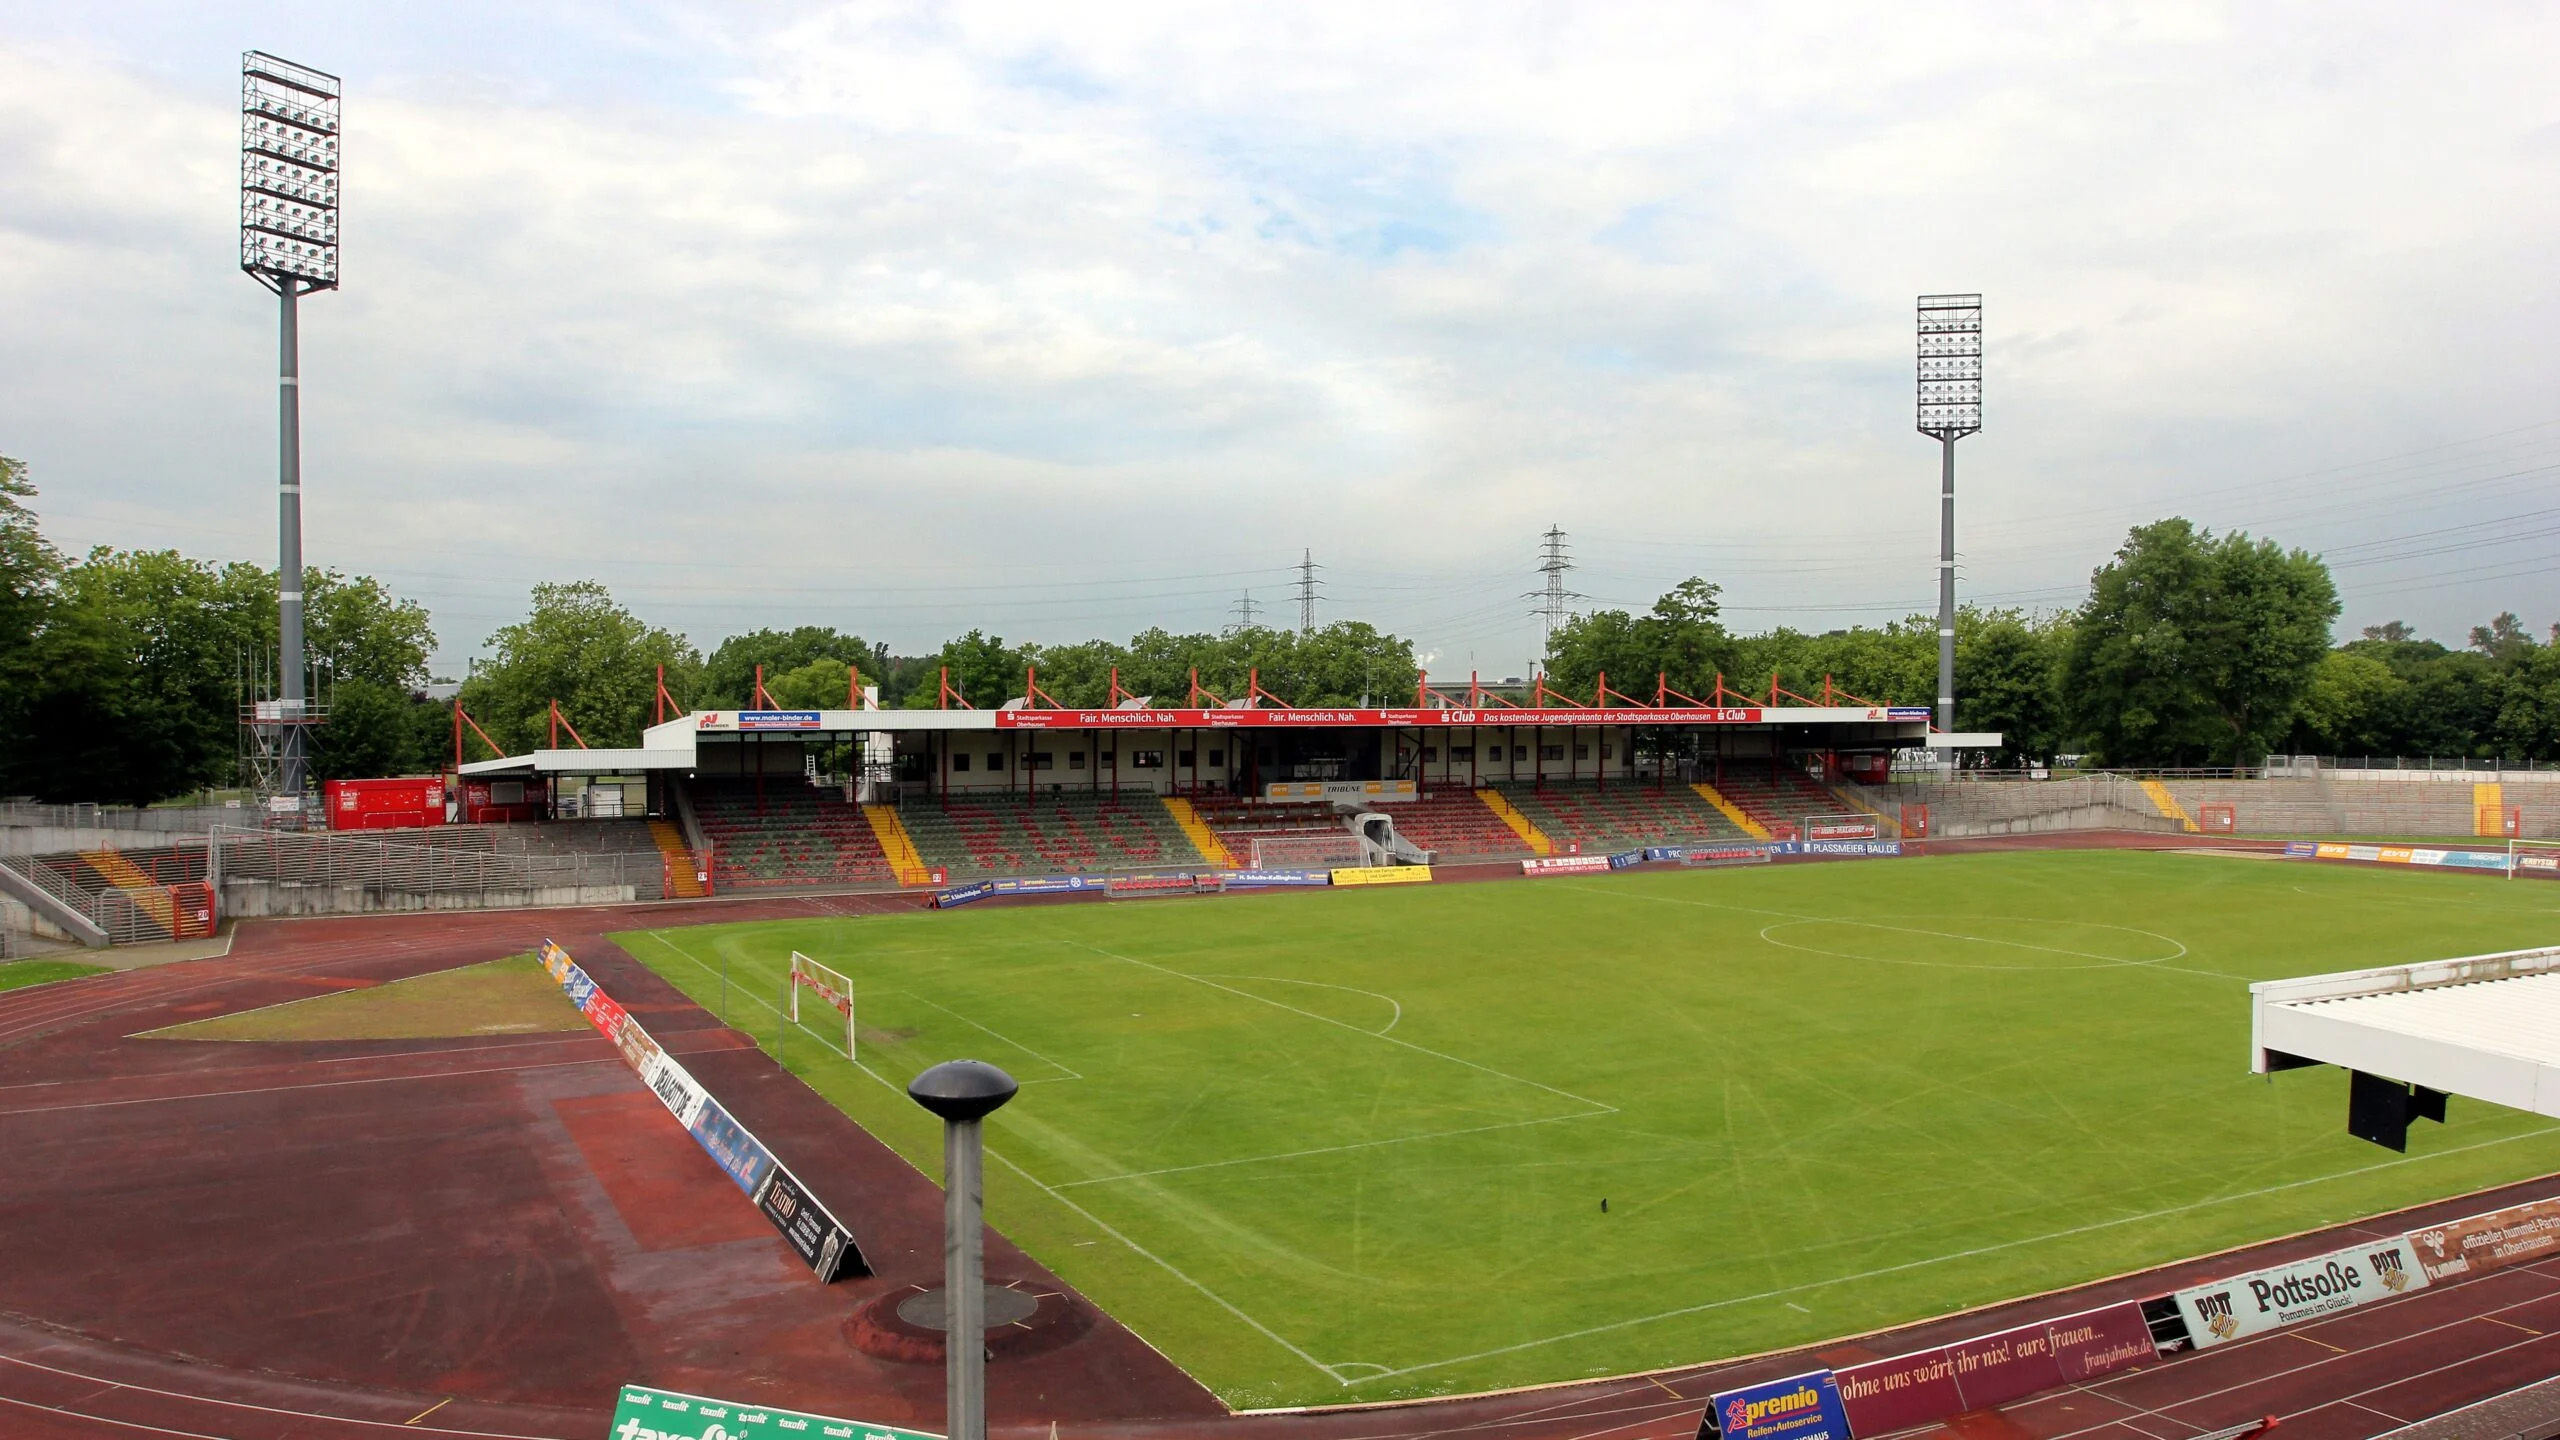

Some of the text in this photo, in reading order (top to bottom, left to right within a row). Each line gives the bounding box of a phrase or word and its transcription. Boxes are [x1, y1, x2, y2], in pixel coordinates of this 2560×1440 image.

[1080, 713, 1177, 723] Fair. Menschlich. Nah.
[1269, 712, 1357, 722] Fair. Menschlich. Nah.
[1452, 710, 1476, 722] Club
[1483, 712, 1711, 725] Das kostenlose Jugendgirokonto der Stadtsparkasse Oberhausen
[1726, 709, 1747, 721] Club
[1813, 844, 1898, 854] PLASSMEIER-BAU.DE
[769, 1180, 797, 1219] TEATRO
[2462, 1229, 2504, 1250] offizieller
[2493, 1235, 2555, 1258] in Oberhausen
[2368, 1247, 2403, 1276] POTT
[2423, 1253, 2470, 1281] hummel
[2248, 1261, 2362, 1313] Pottsoße
[2194, 1291, 2233, 1322] POTT
[2278, 1294, 2354, 1323] Pommes im Glück!
[2083, 1337, 2152, 1374] fraujahnke.de
[1843, 1375, 1881, 1401] ohne
[1883, 1371, 1911, 1391] uns
[1913, 1358, 1954, 1384] wärt
[1956, 1349, 1980, 1374] ihr
[1982, 1340, 2011, 1367] nix!
[2016, 1337, 2046, 1358] eure
[2048, 1326, 2104, 1357] frauen...
[625, 1392, 653, 1406] taxofit
[662, 1399, 690, 1412] taxofit
[1746, 1385, 1818, 1427] premio
[700, 1406, 729, 1419] taxofit
[738, 1412, 768, 1425] taxofit
[778, 1417, 808, 1431] taxofit
[823, 1425, 854, 1438] taxofit
